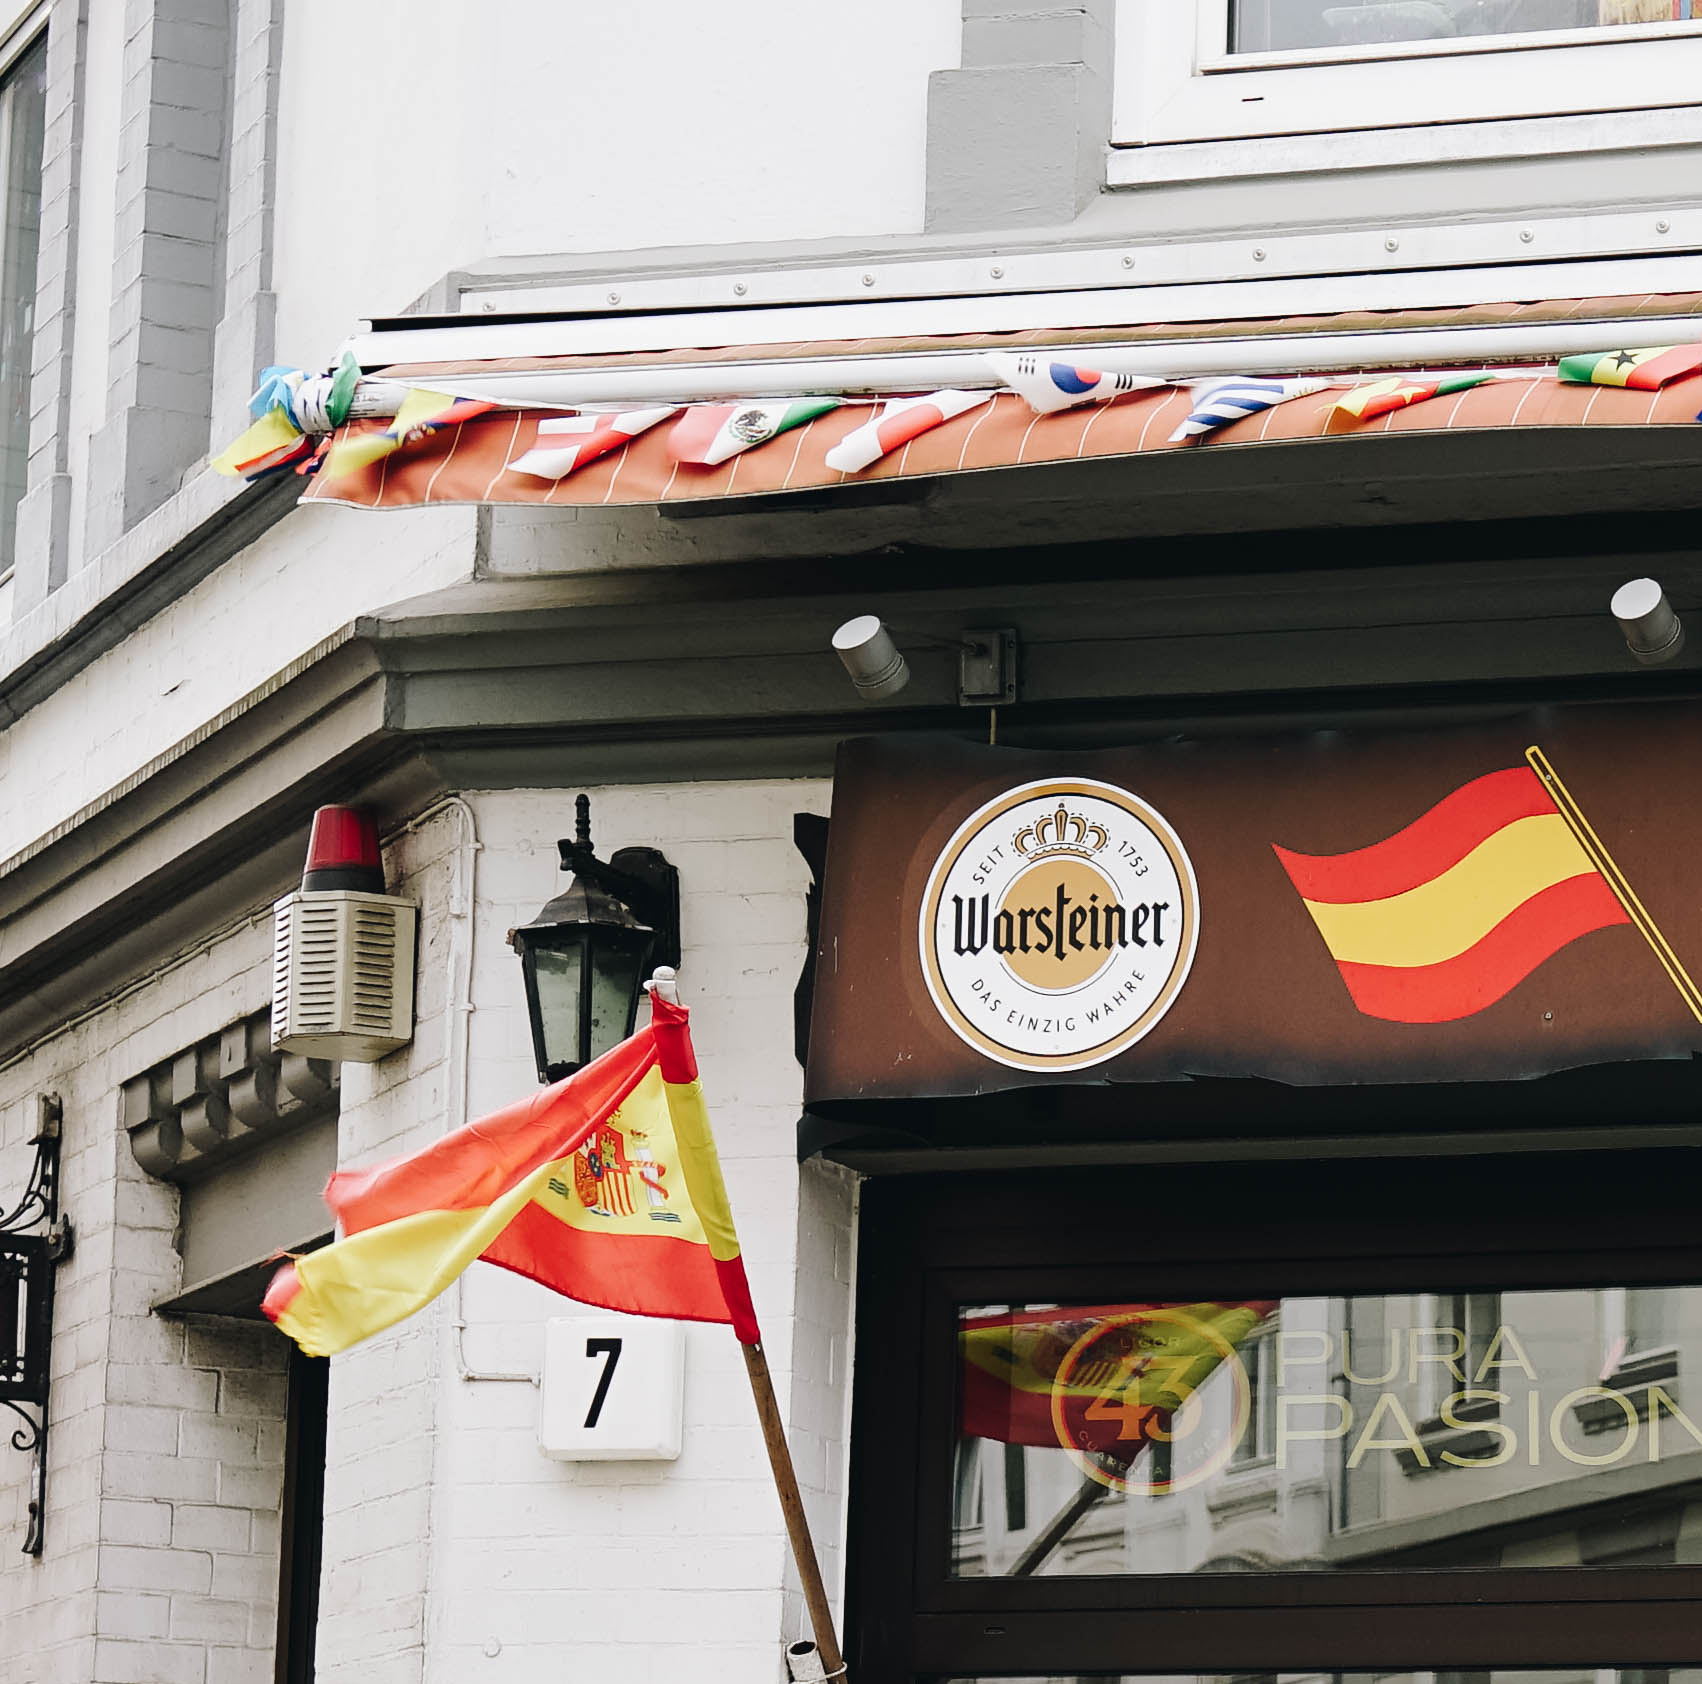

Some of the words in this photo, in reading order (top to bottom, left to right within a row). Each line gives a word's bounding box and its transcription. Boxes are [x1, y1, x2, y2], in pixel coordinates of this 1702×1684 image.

[972, 844, 1004, 885] SEIT
[1118, 840, 1149, 878] 1753
[951, 883, 1171, 962] Warsteiner
[971, 978, 1002, 1013] DAS
[1006, 1010, 1077, 1033] EINZIG
[1086, 968, 1146, 1025] WAHRE
[583, 1337, 623, 1429] 7
[1276, 1325, 1539, 1387] PURA
[1084, 1355, 1203, 1442] 43
